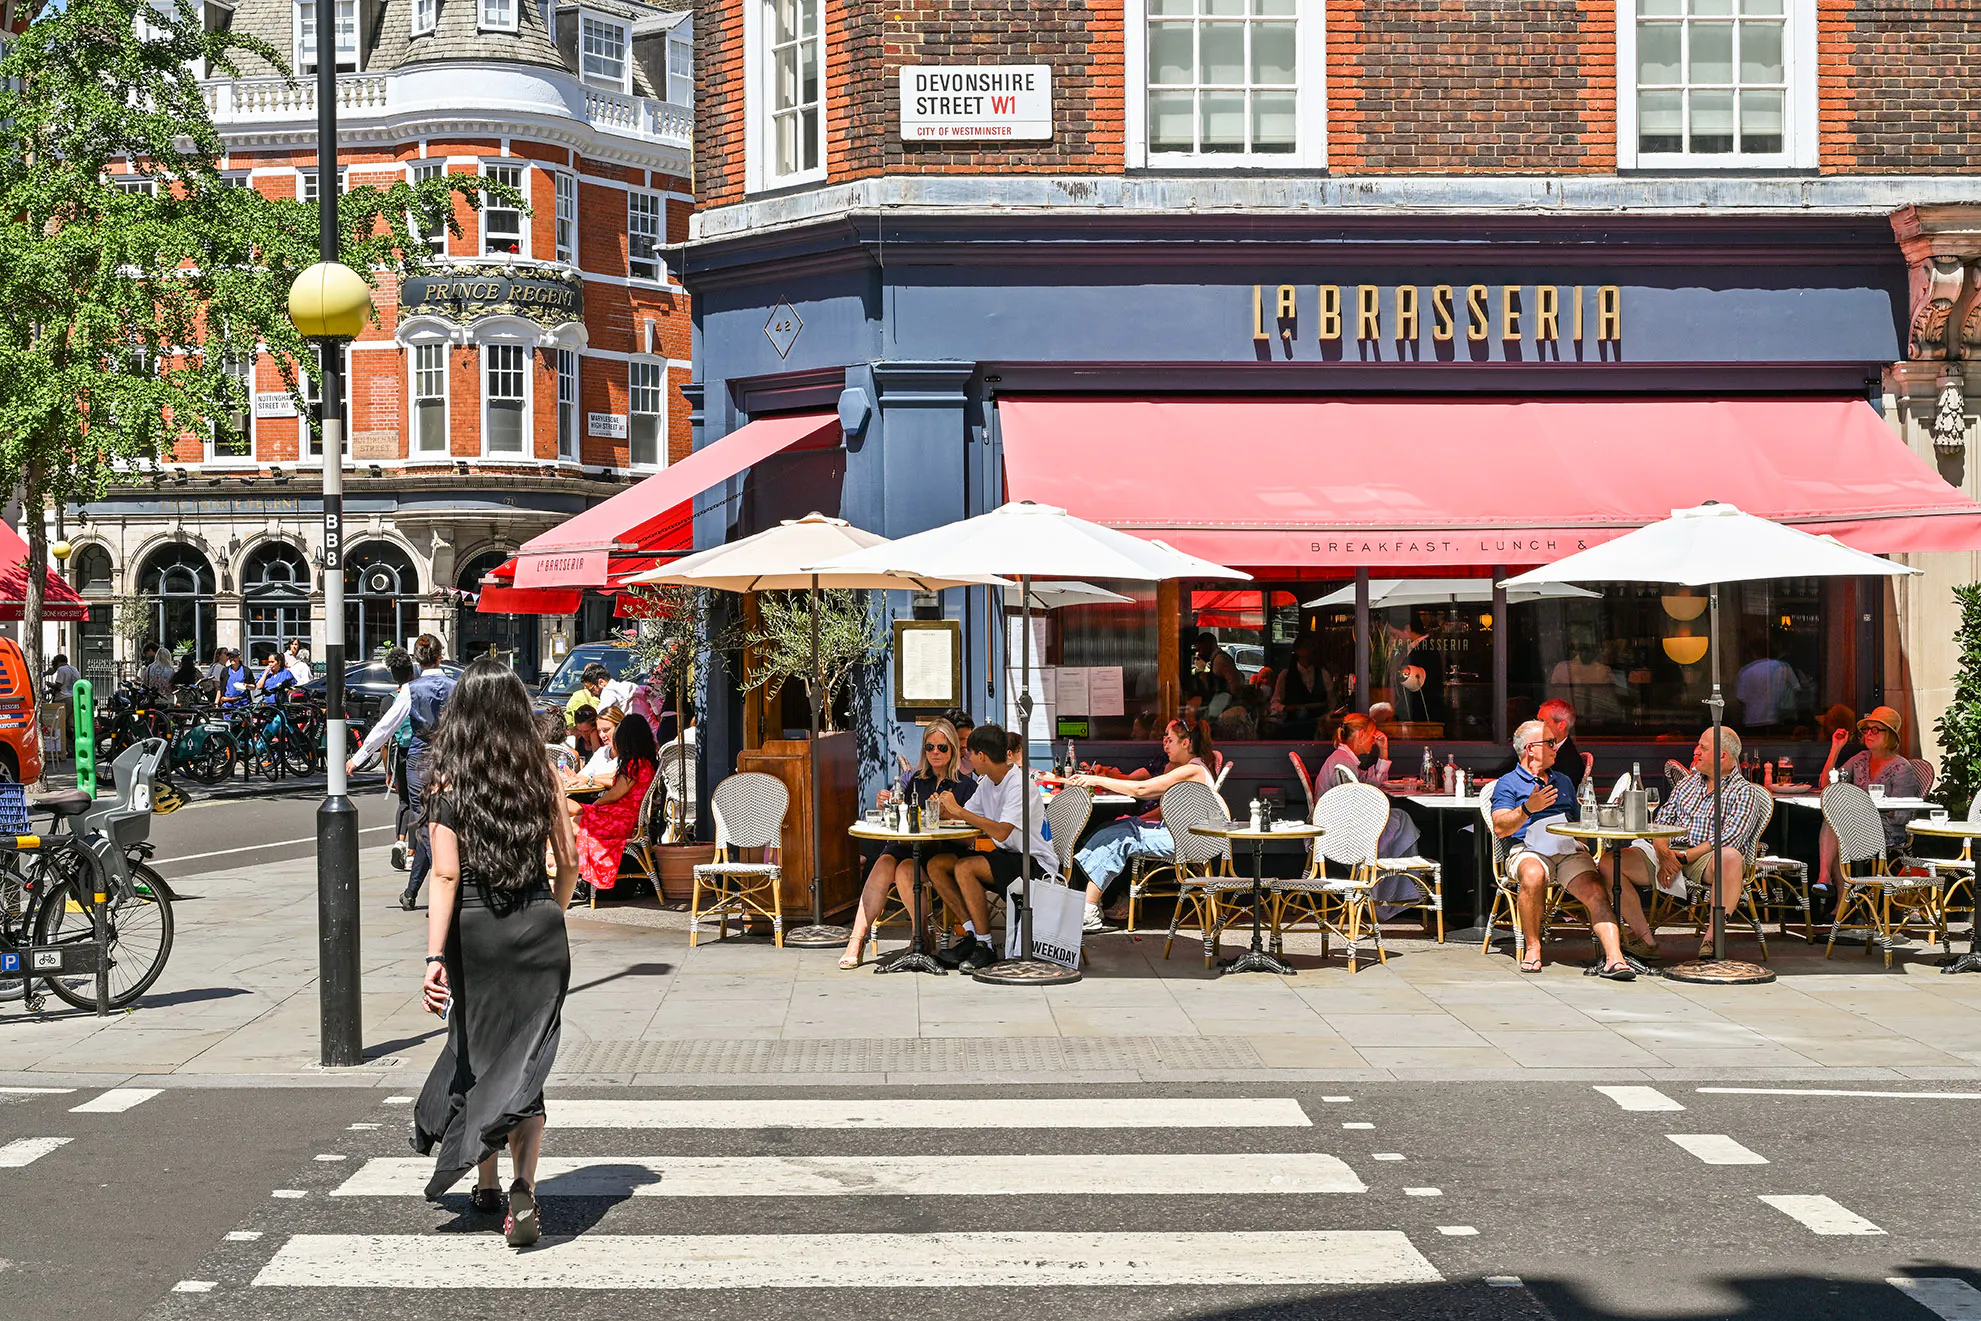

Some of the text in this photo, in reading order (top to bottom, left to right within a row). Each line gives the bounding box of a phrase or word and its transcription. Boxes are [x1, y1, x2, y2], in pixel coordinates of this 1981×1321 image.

[916, 73, 1035, 92] DEVONSHIRE
[916, 95, 1016, 115] STREET W1
[917, 126, 1012, 136] CITY OF WESTMINSTER
[424, 282, 576, 307] PRINCE REGENT
[1318, 284, 1622, 341] BRASSERIA
[775, 319, 791, 333] 42
[257, 402, 279, 410] STREET
[602, 422, 618, 431] STREET
[246, 498, 299, 510] REGENT
[1480, 541, 1557, 551] LUNCH
[1577, 539, 1588, 551] &
[1032, 940, 1077, 965] WEEKDAY
[5, 955, 17, 970] P
